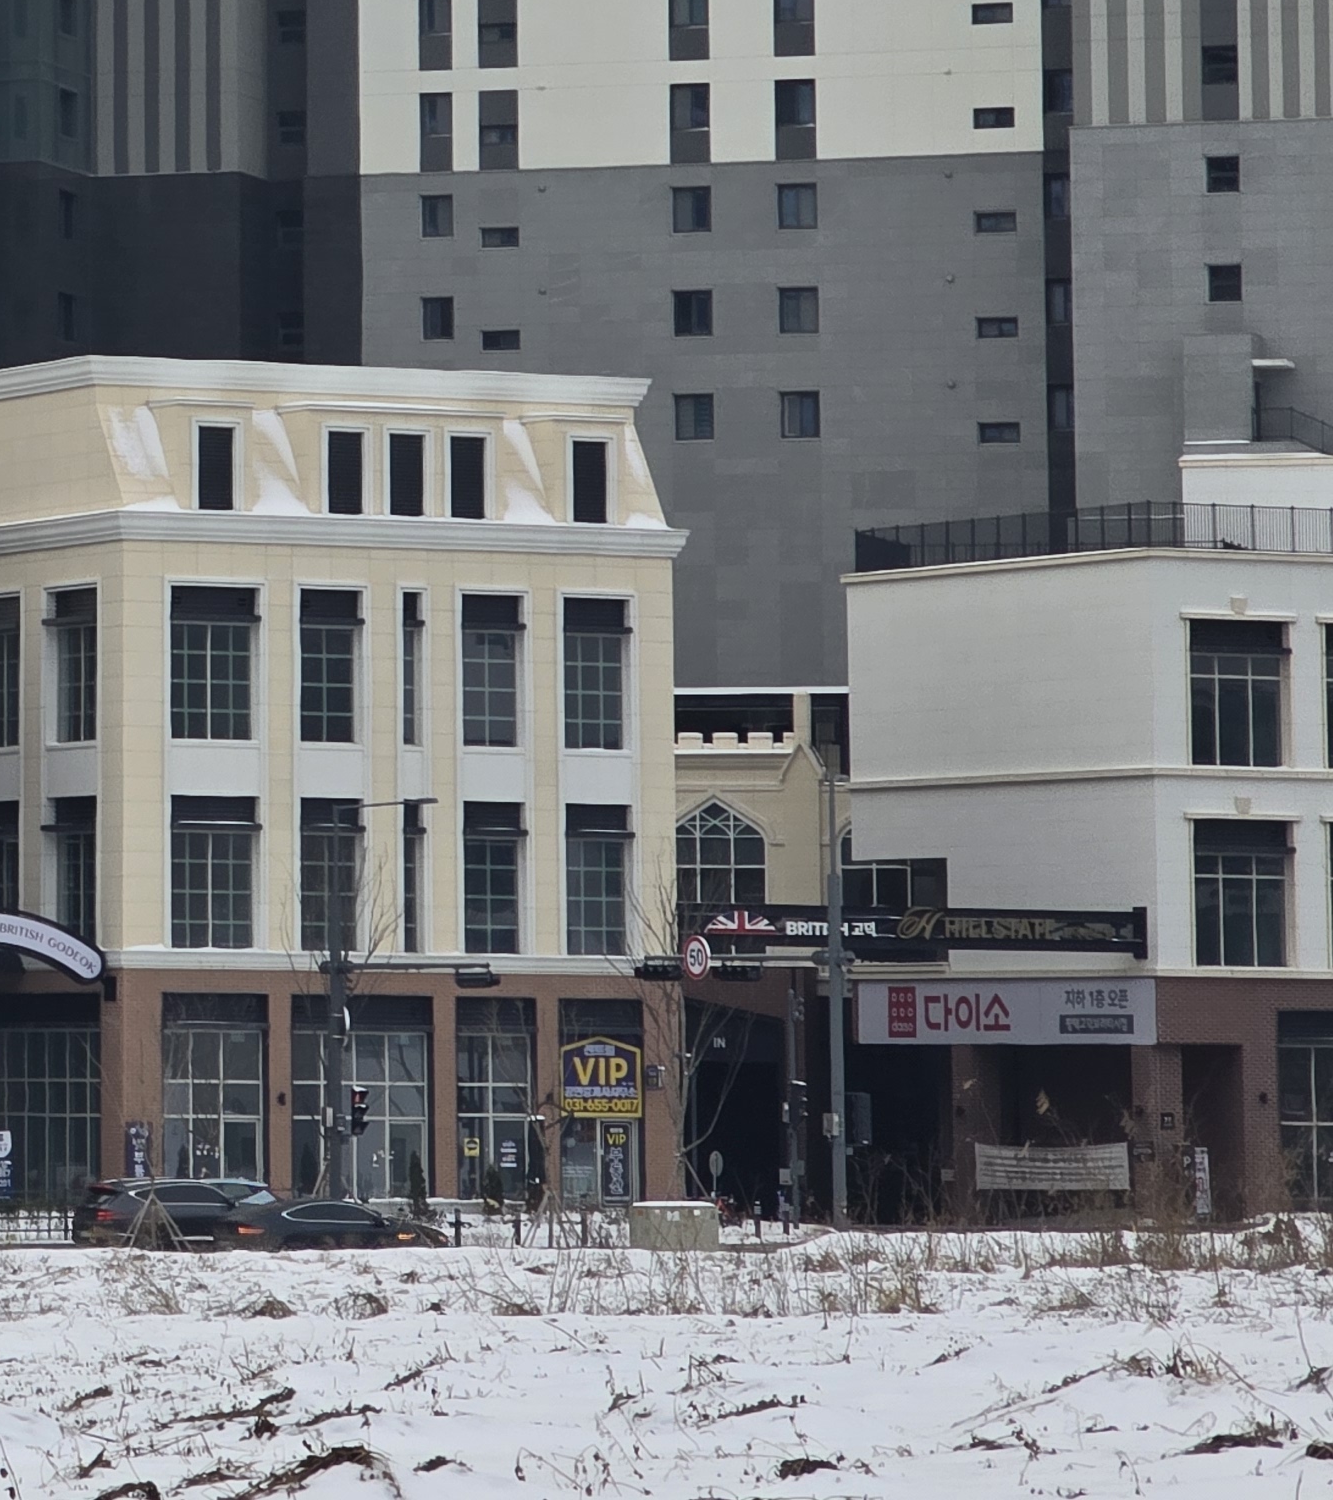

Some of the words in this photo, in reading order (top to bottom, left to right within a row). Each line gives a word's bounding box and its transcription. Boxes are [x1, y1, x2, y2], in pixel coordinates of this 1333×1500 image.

[785, 921, 849, 937] BRITIH
[47, 937, 97, 974] GODEOK
[689, 948, 704, 967] 50
[1064, 989, 1086, 1009] 지하
[1088, 988, 1106, 1009] 1층
[1107, 988, 1130, 1010] 오픈
[923, 992, 1011, 1032] 다이소
[713, 1037, 726, 1048] IN
[573, 1056, 628, 1086] VIP
[606, 1133, 627, 1146] VIP
